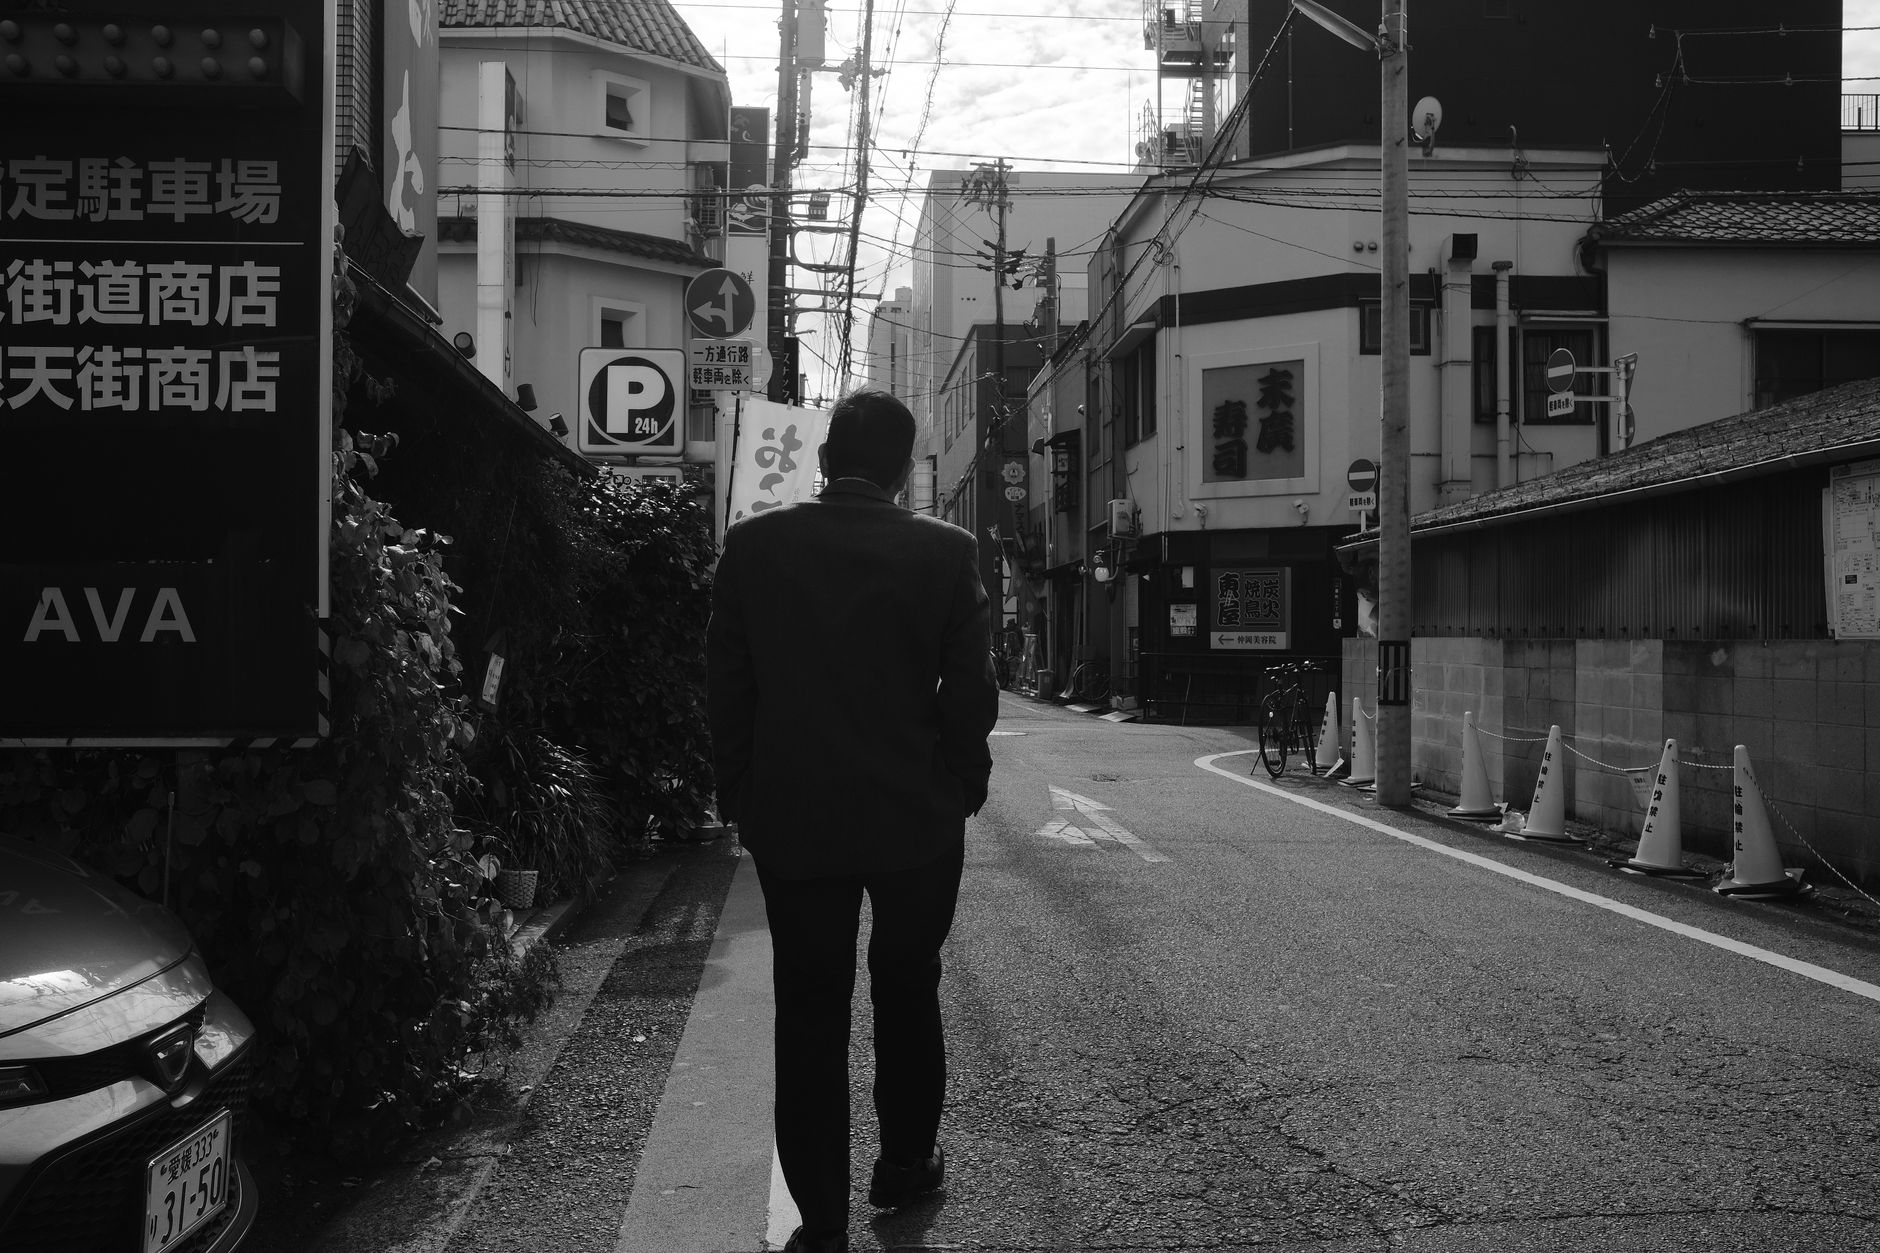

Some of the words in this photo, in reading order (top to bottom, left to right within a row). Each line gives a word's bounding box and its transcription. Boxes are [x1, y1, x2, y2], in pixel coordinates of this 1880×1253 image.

[0, 155, 282, 224] 定駐車場
[0, 258, 281, 328] 街道商店
[0, 345, 281, 413] 天街商店
[693, 345, 749, 363] 一方通行路
[693, 367, 750, 385] 軽車両を除く
[606, 365, 666, 434] P
[634, 417, 659, 435] 24h
[1212, 400, 1248, 478] 寿司
[23, 586, 198, 643] AVA
[1644, 773, 1668, 834] 駐輪禁止
[1734, 785, 1744, 852] 駐輪禁止
[161, 1157, 223, 1244] 31-50
